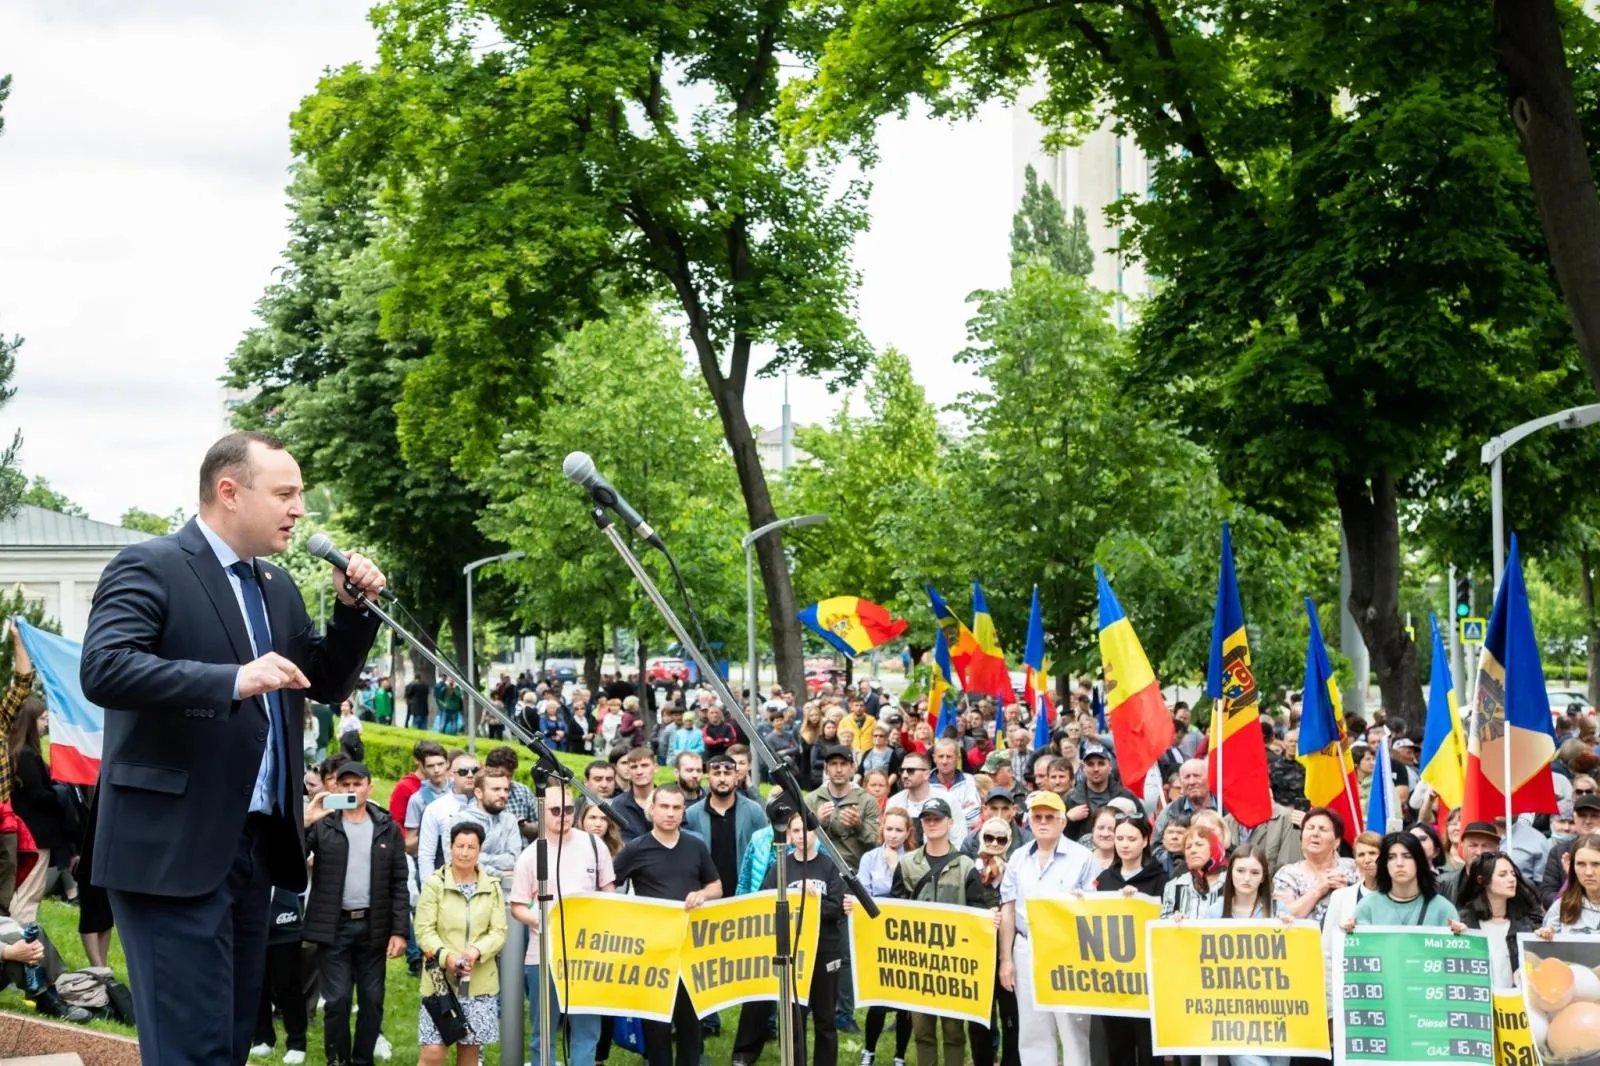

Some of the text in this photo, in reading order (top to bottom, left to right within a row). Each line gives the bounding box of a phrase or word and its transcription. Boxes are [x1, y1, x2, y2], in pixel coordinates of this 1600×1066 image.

[691, 907, 800, 948] Vremui
[885, 917, 956, 950] САНДУ
[575, 928, 645, 955] A ajuns
[1076, 914, 1136, 963] NU
[1199, 928, 1287, 964] ДОЛОЙ
[1445, 938, 1471, 949] 2022
[877, 946, 979, 976] ЛИКВИДАТОР
[1342, 958, 1381, 972] 21.40
[1424, 959, 1489, 975] 98 31.55
[618, 964, 640, 986] LA
[644, 966, 671, 989] OS
[879, 967, 979, 1001] МОЛДОВЫ
[1200, 966, 1290, 990] ВЛАСТЬ
[1343, 984, 1383, 999] 20.80
[1425, 985, 1490, 1002] 95 30.30
[1185, 998, 1309, 1017] РАЗДЕЛЯЮЩУЮ
[1349, 1011, 1385, 1026] 16.75
[1417, 1012, 1491, 1029] Diesel 27.11
[1210, 1016, 1287, 1045] ЛЮДЕЙ
[1352, 1038, 1386, 1053] 10.92
[1427, 1046, 1450, 1056] GAZ
